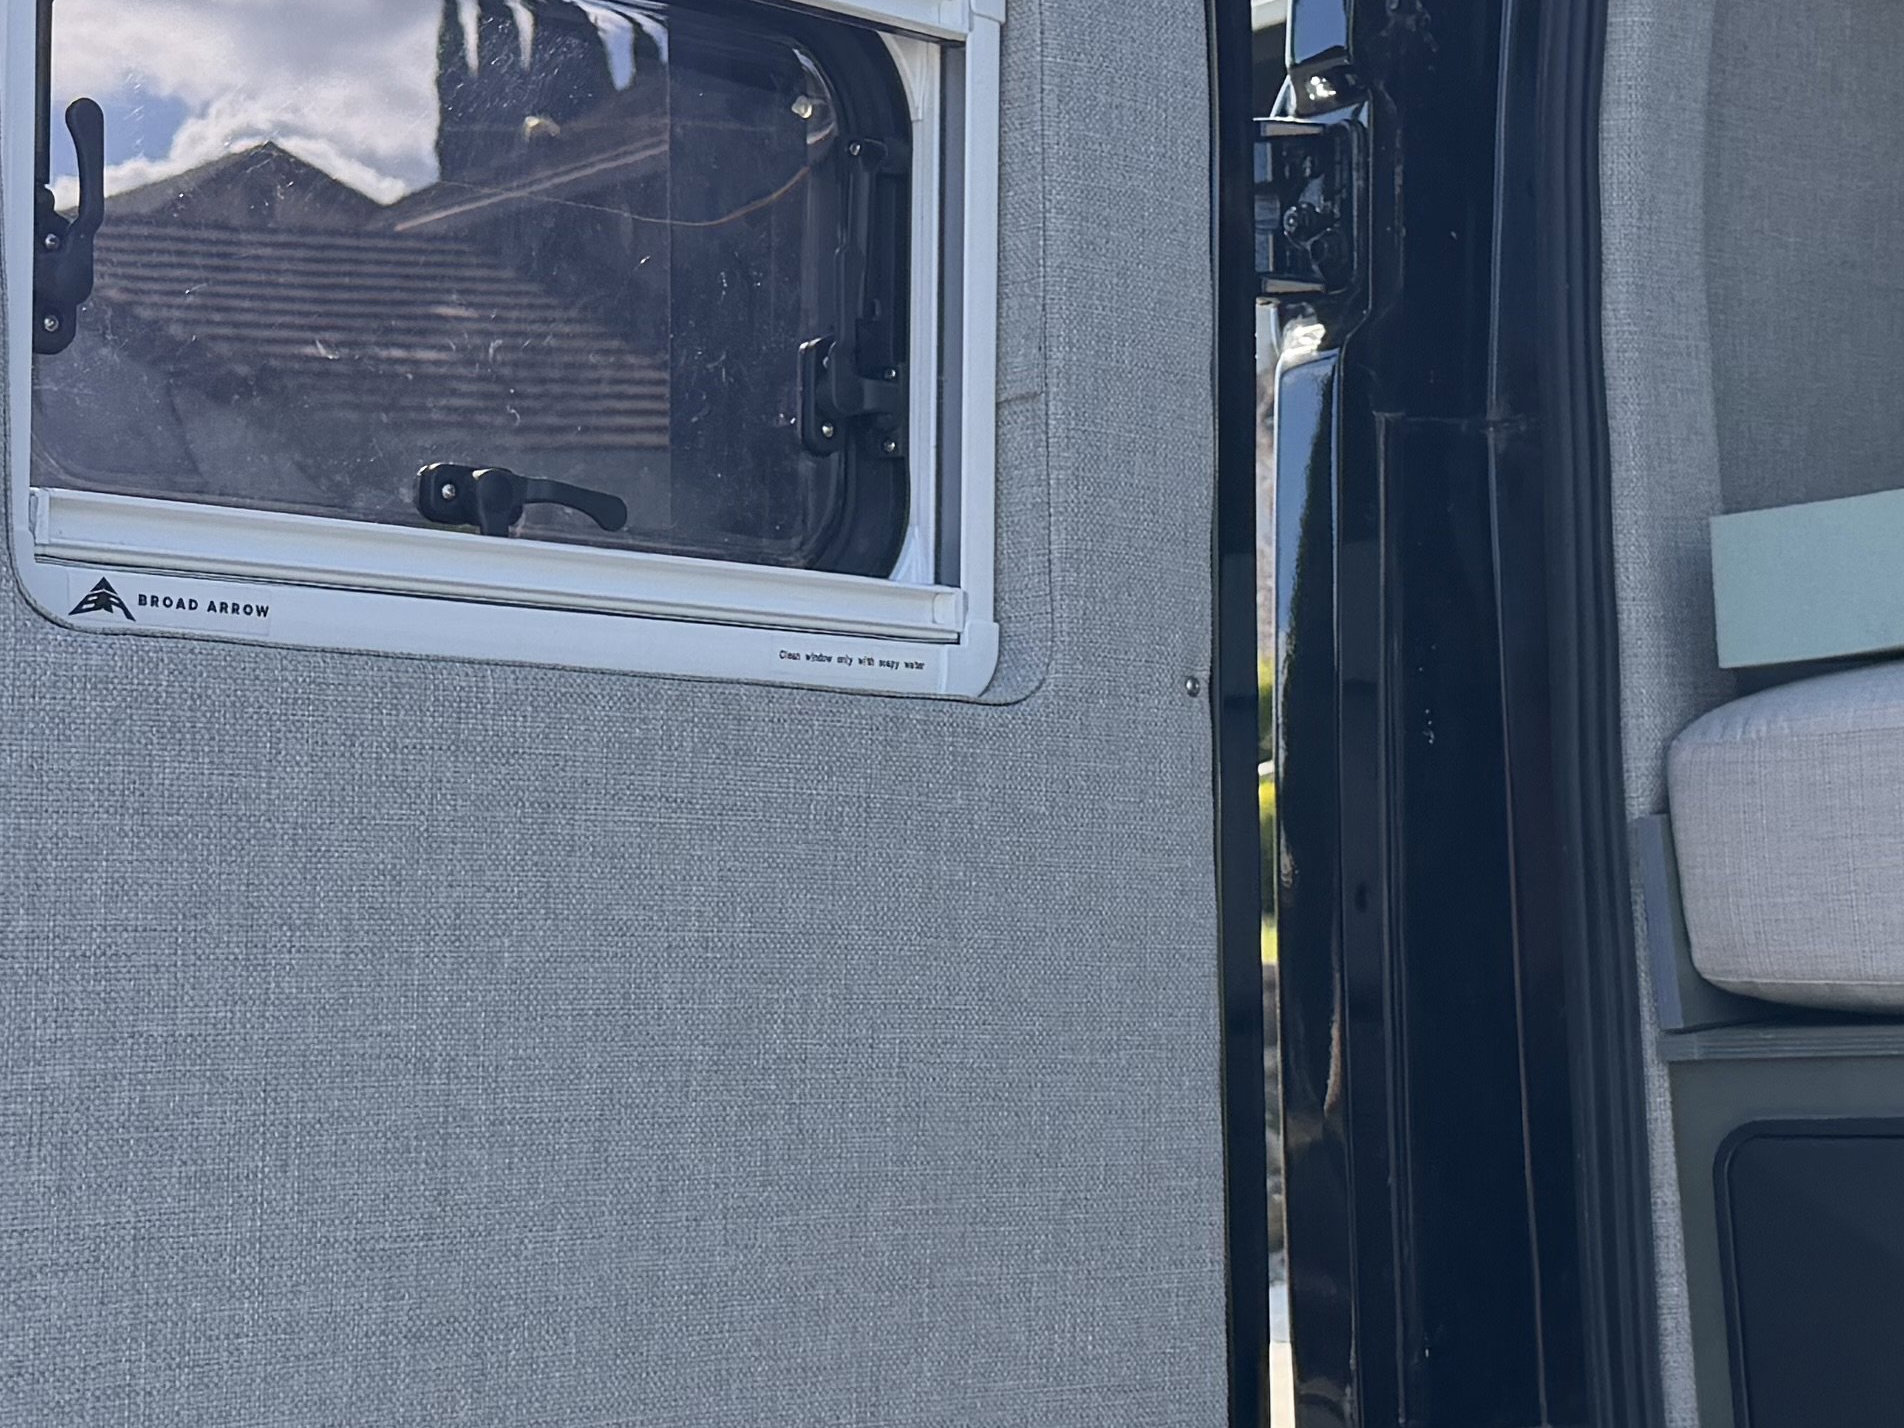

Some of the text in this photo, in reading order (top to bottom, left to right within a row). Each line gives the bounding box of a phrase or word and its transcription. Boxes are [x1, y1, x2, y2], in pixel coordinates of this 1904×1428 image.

[137, 594, 270, 618] BROAD ARROW
[778, 649, 801, 661] Clean
[805, 651, 833, 663] window
[836, 653, 853, 667] only
[858, 655, 875, 667] with
